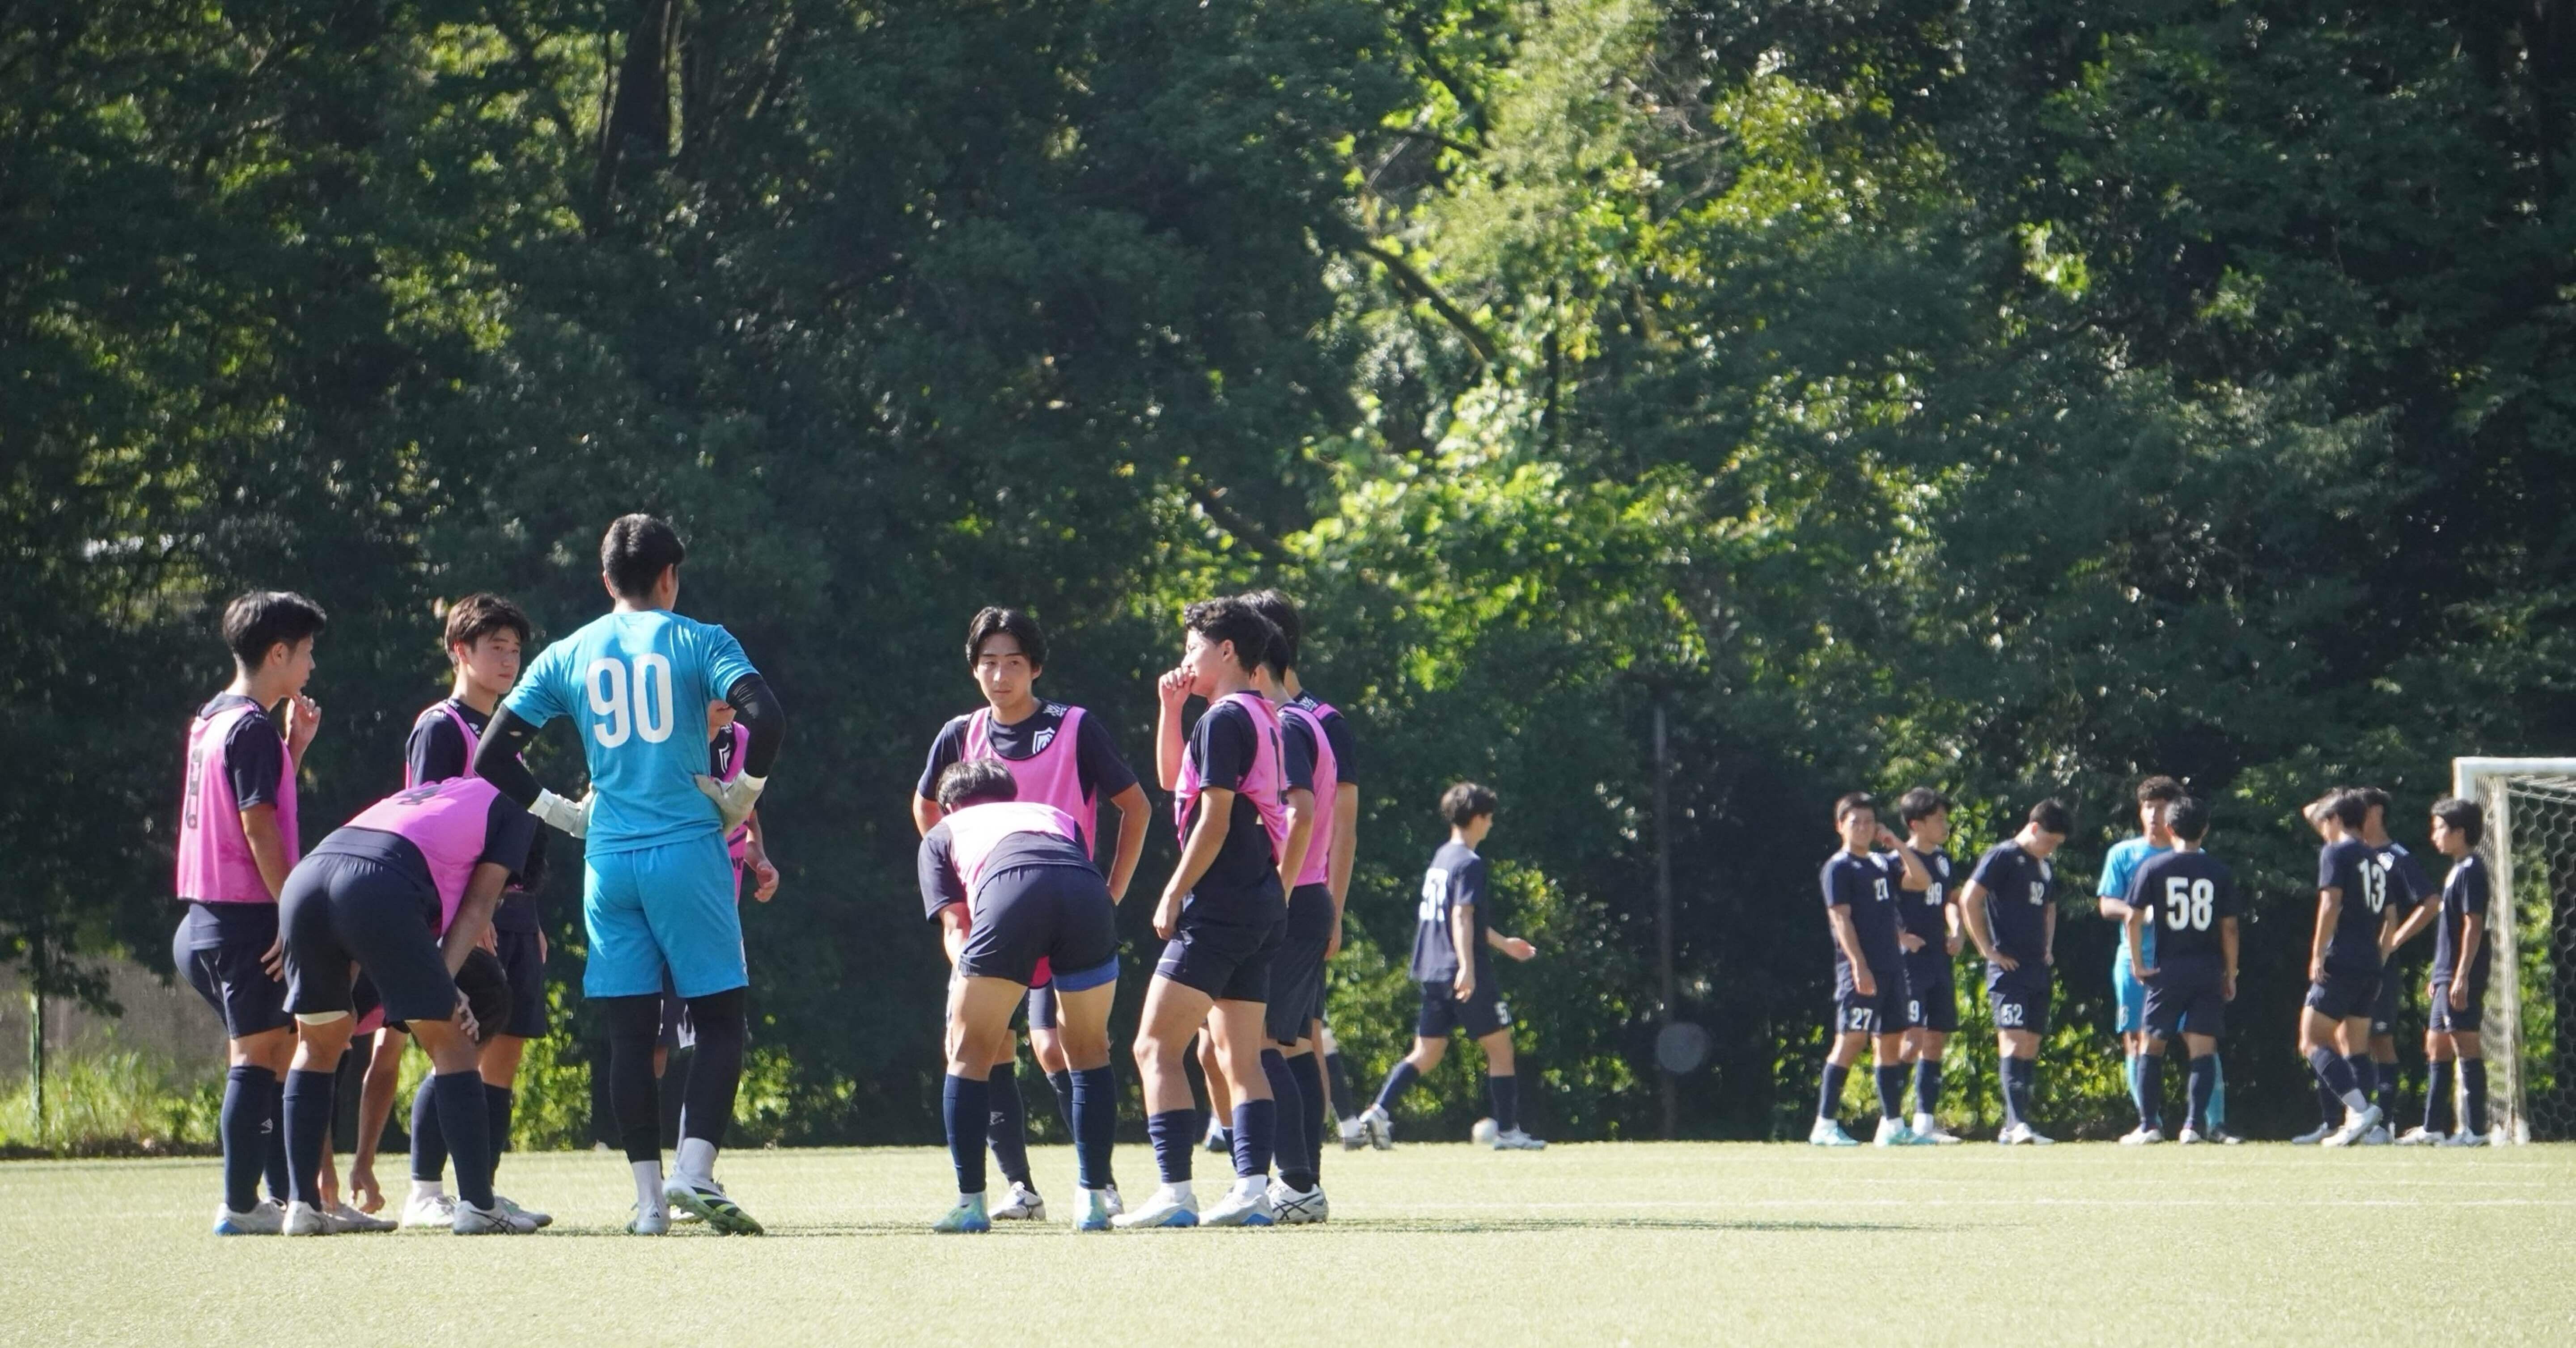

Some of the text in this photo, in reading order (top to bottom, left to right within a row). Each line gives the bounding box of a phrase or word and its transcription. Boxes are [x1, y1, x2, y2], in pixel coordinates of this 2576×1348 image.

[586, 653, 674, 748] 90
[2165, 877, 2214, 932] 58
[2357, 858, 2386, 914] 13
[1849, 1006, 1873, 1031] 27
[2001, 1002, 2024, 1027] 52
